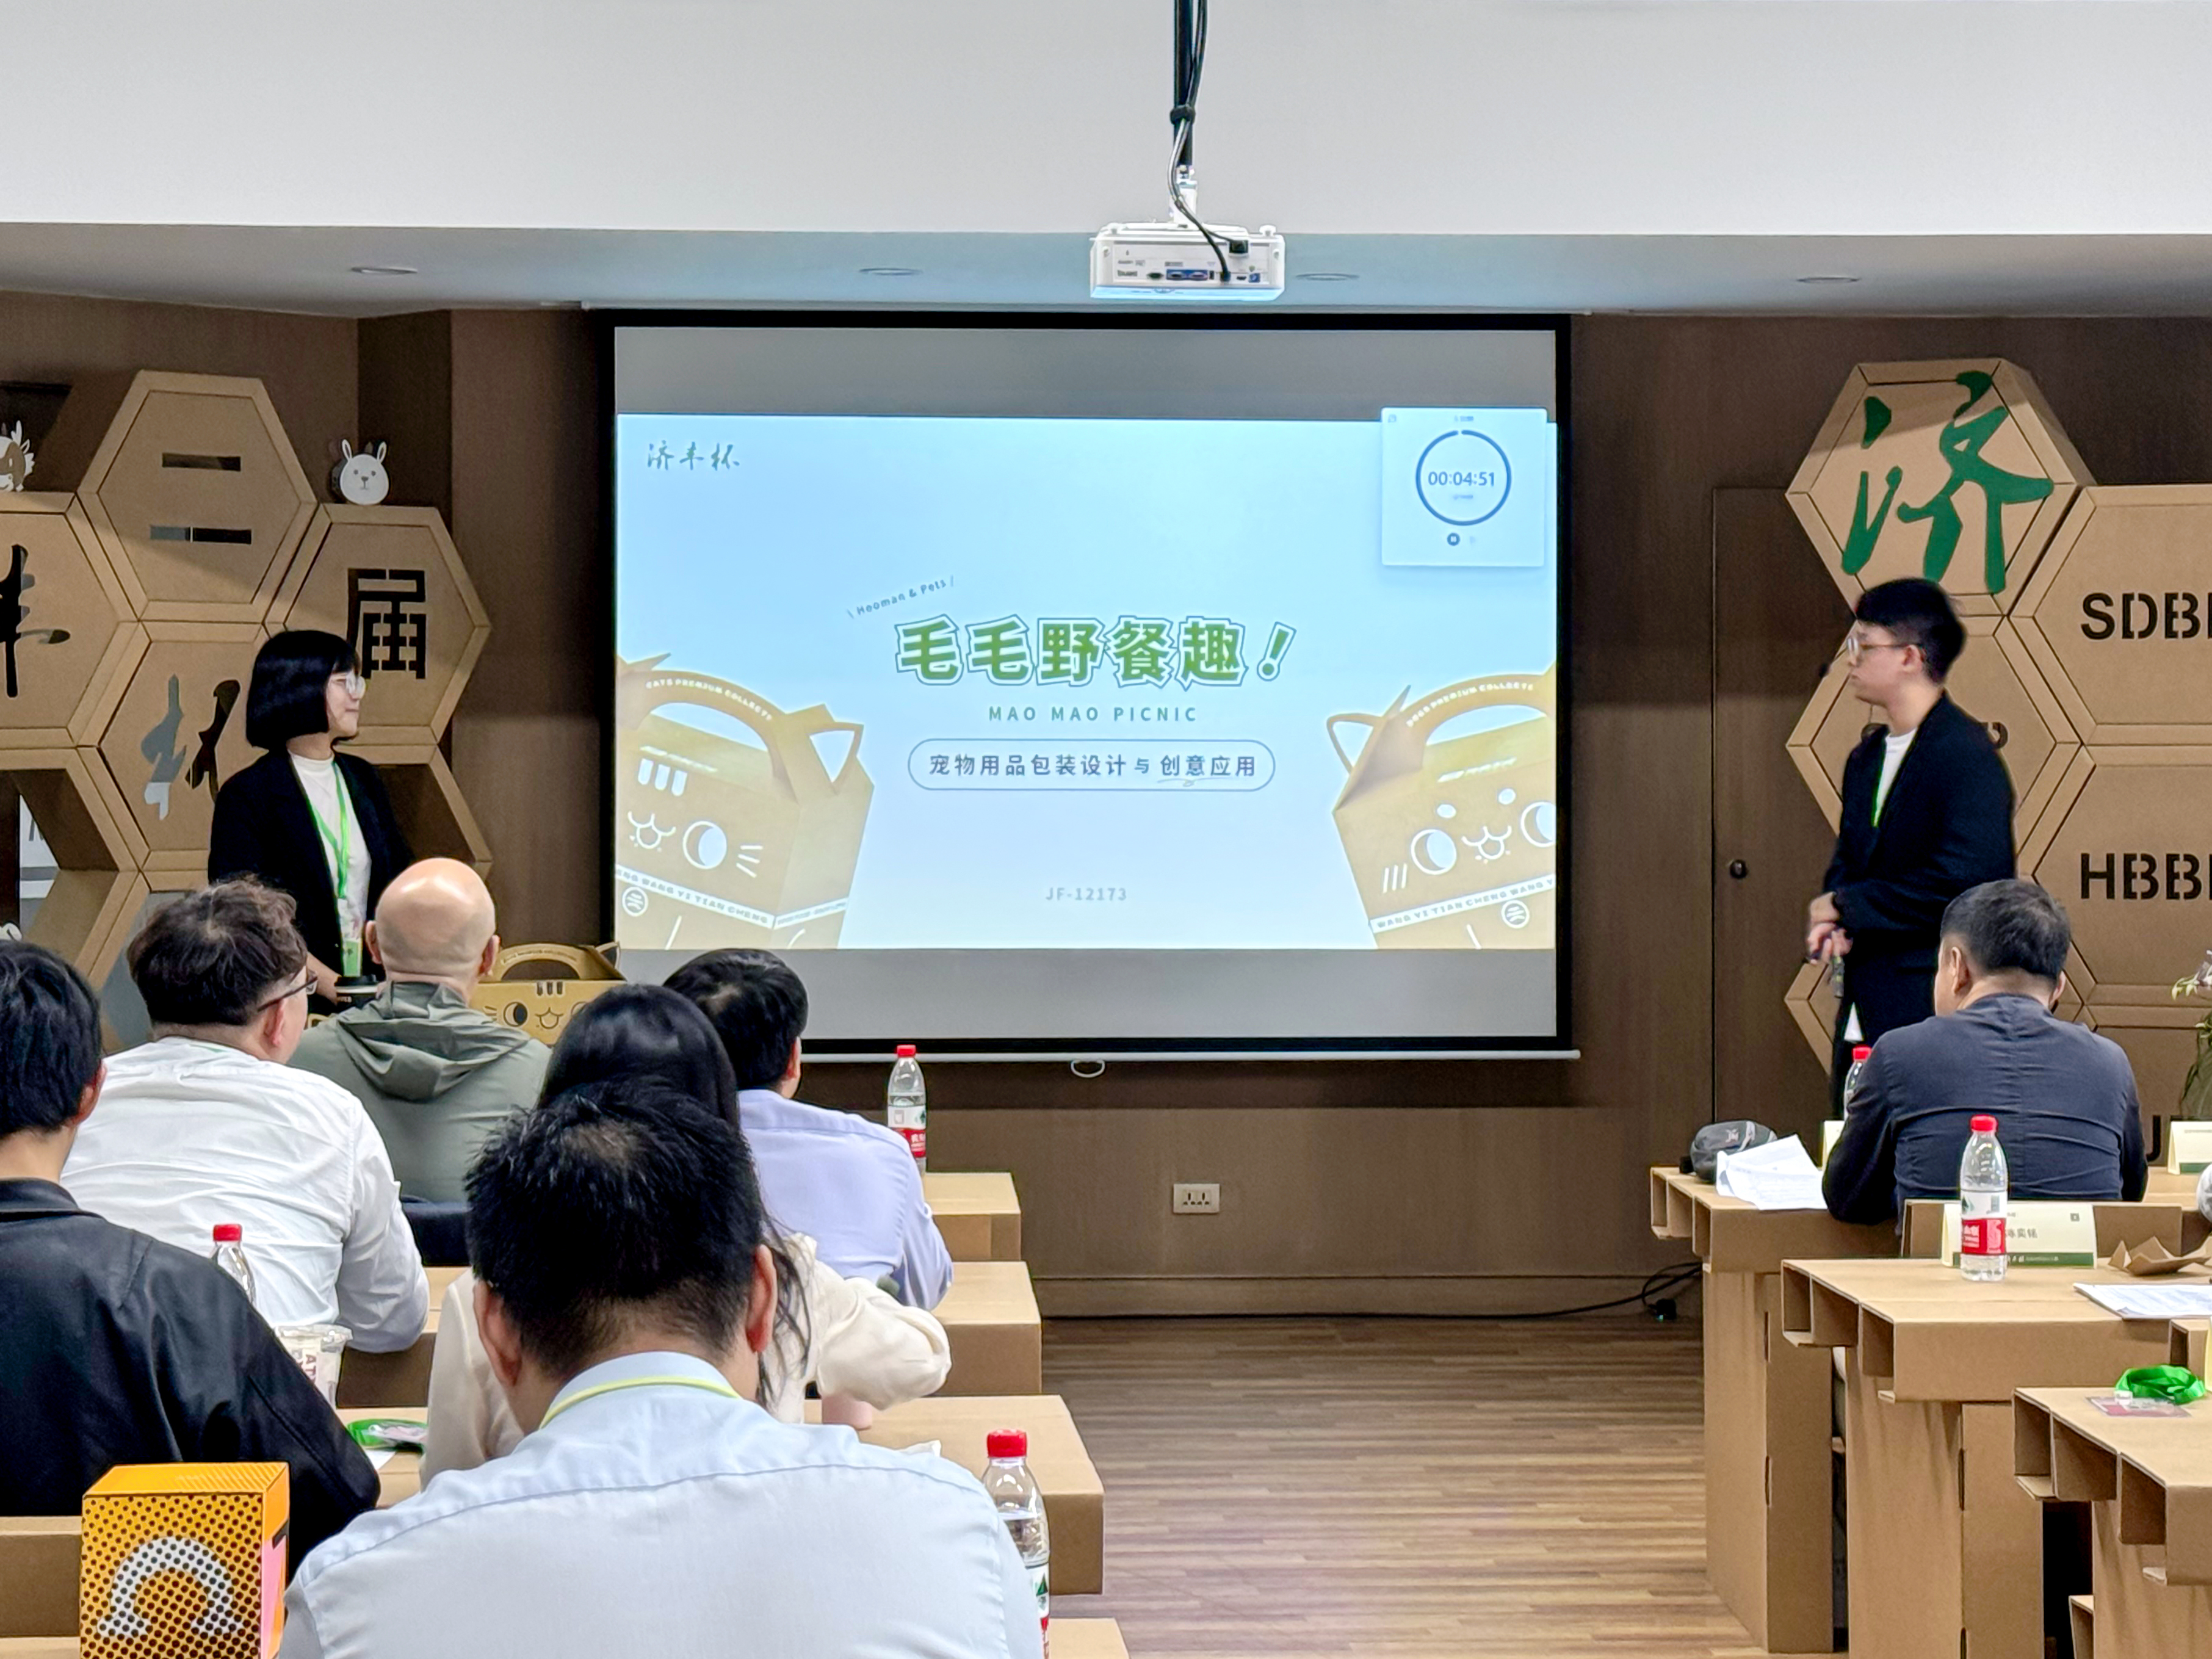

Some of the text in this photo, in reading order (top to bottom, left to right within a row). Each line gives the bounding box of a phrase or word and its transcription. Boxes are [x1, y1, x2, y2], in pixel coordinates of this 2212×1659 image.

[149, 452, 252, 545] 二
[1427, 471, 1495, 487] 00:04:51
[856, 579, 946, 615] Hooman & Pets
[2081, 592, 2212, 640] SDB
[346, 568, 427, 681] 届
[989, 706, 1196, 721] MAO MAO PICNIC
[1046, 887, 1127, 901] JF-12173
[2081, 853, 2212, 900] HBB
